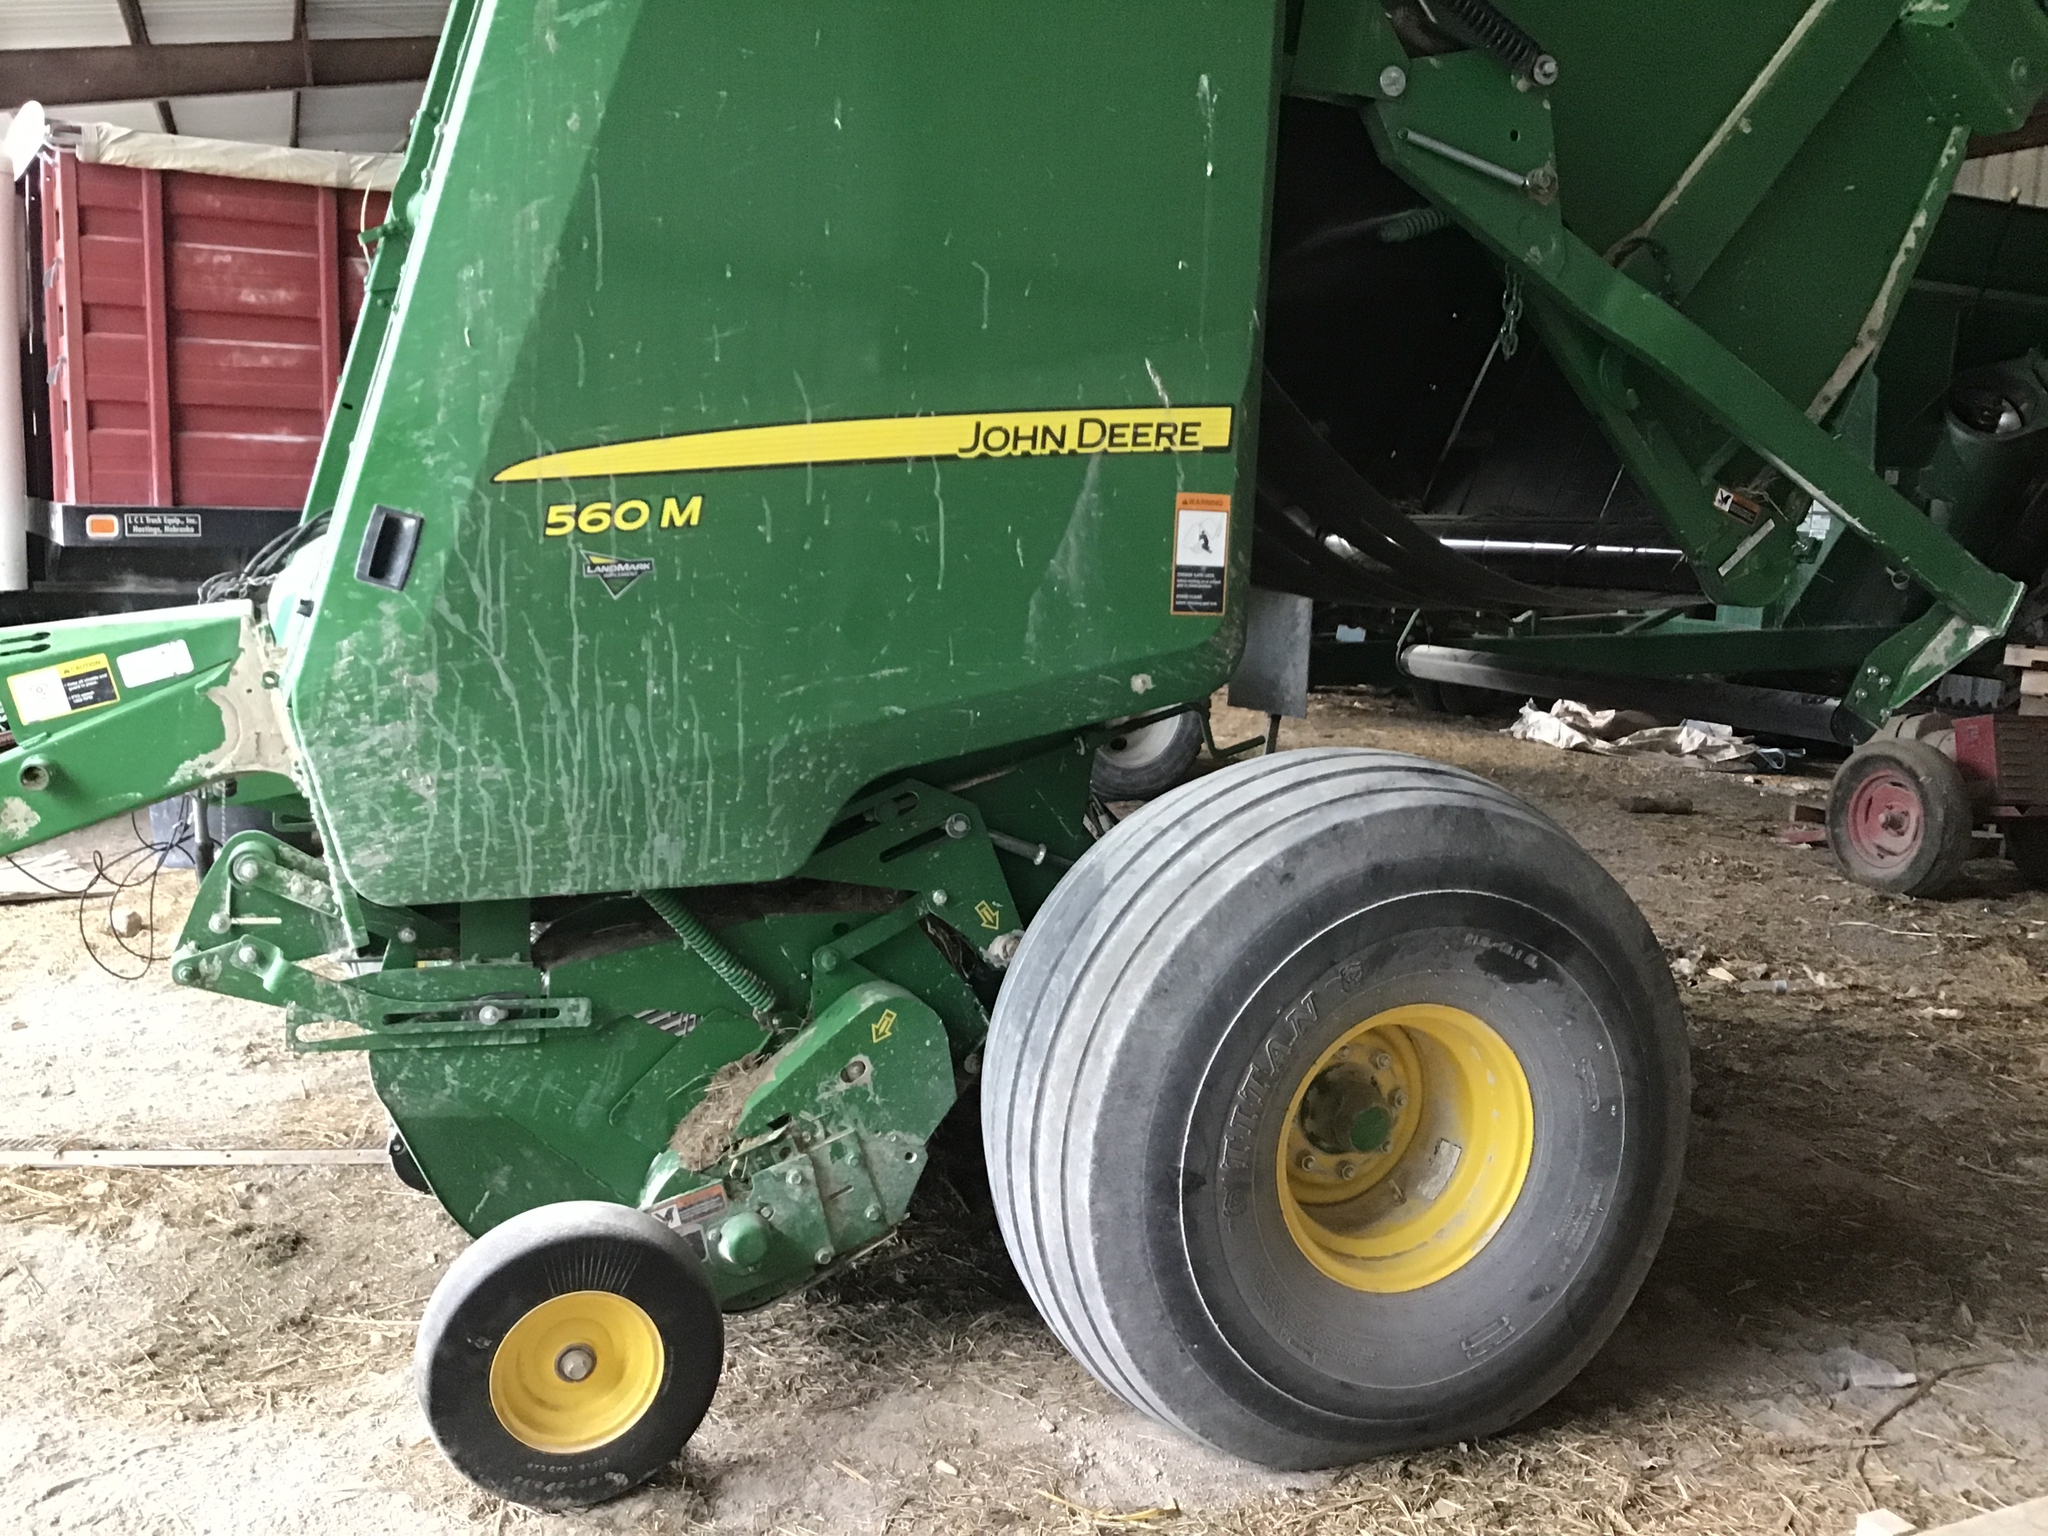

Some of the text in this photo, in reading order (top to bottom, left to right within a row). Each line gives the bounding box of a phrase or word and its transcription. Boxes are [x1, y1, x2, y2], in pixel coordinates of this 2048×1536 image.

[958, 417, 1202, 454] JOHN DEERE
[1189, 499, 1224, 507] WARNING
[145, 515, 162, 524] Truck
[545, 495, 703, 537] 560 M
[164, 525, 195, 533] Nebraska
[71, 661, 101, 671] CAUTION
[1219, 990, 1318, 1169] TITAN
